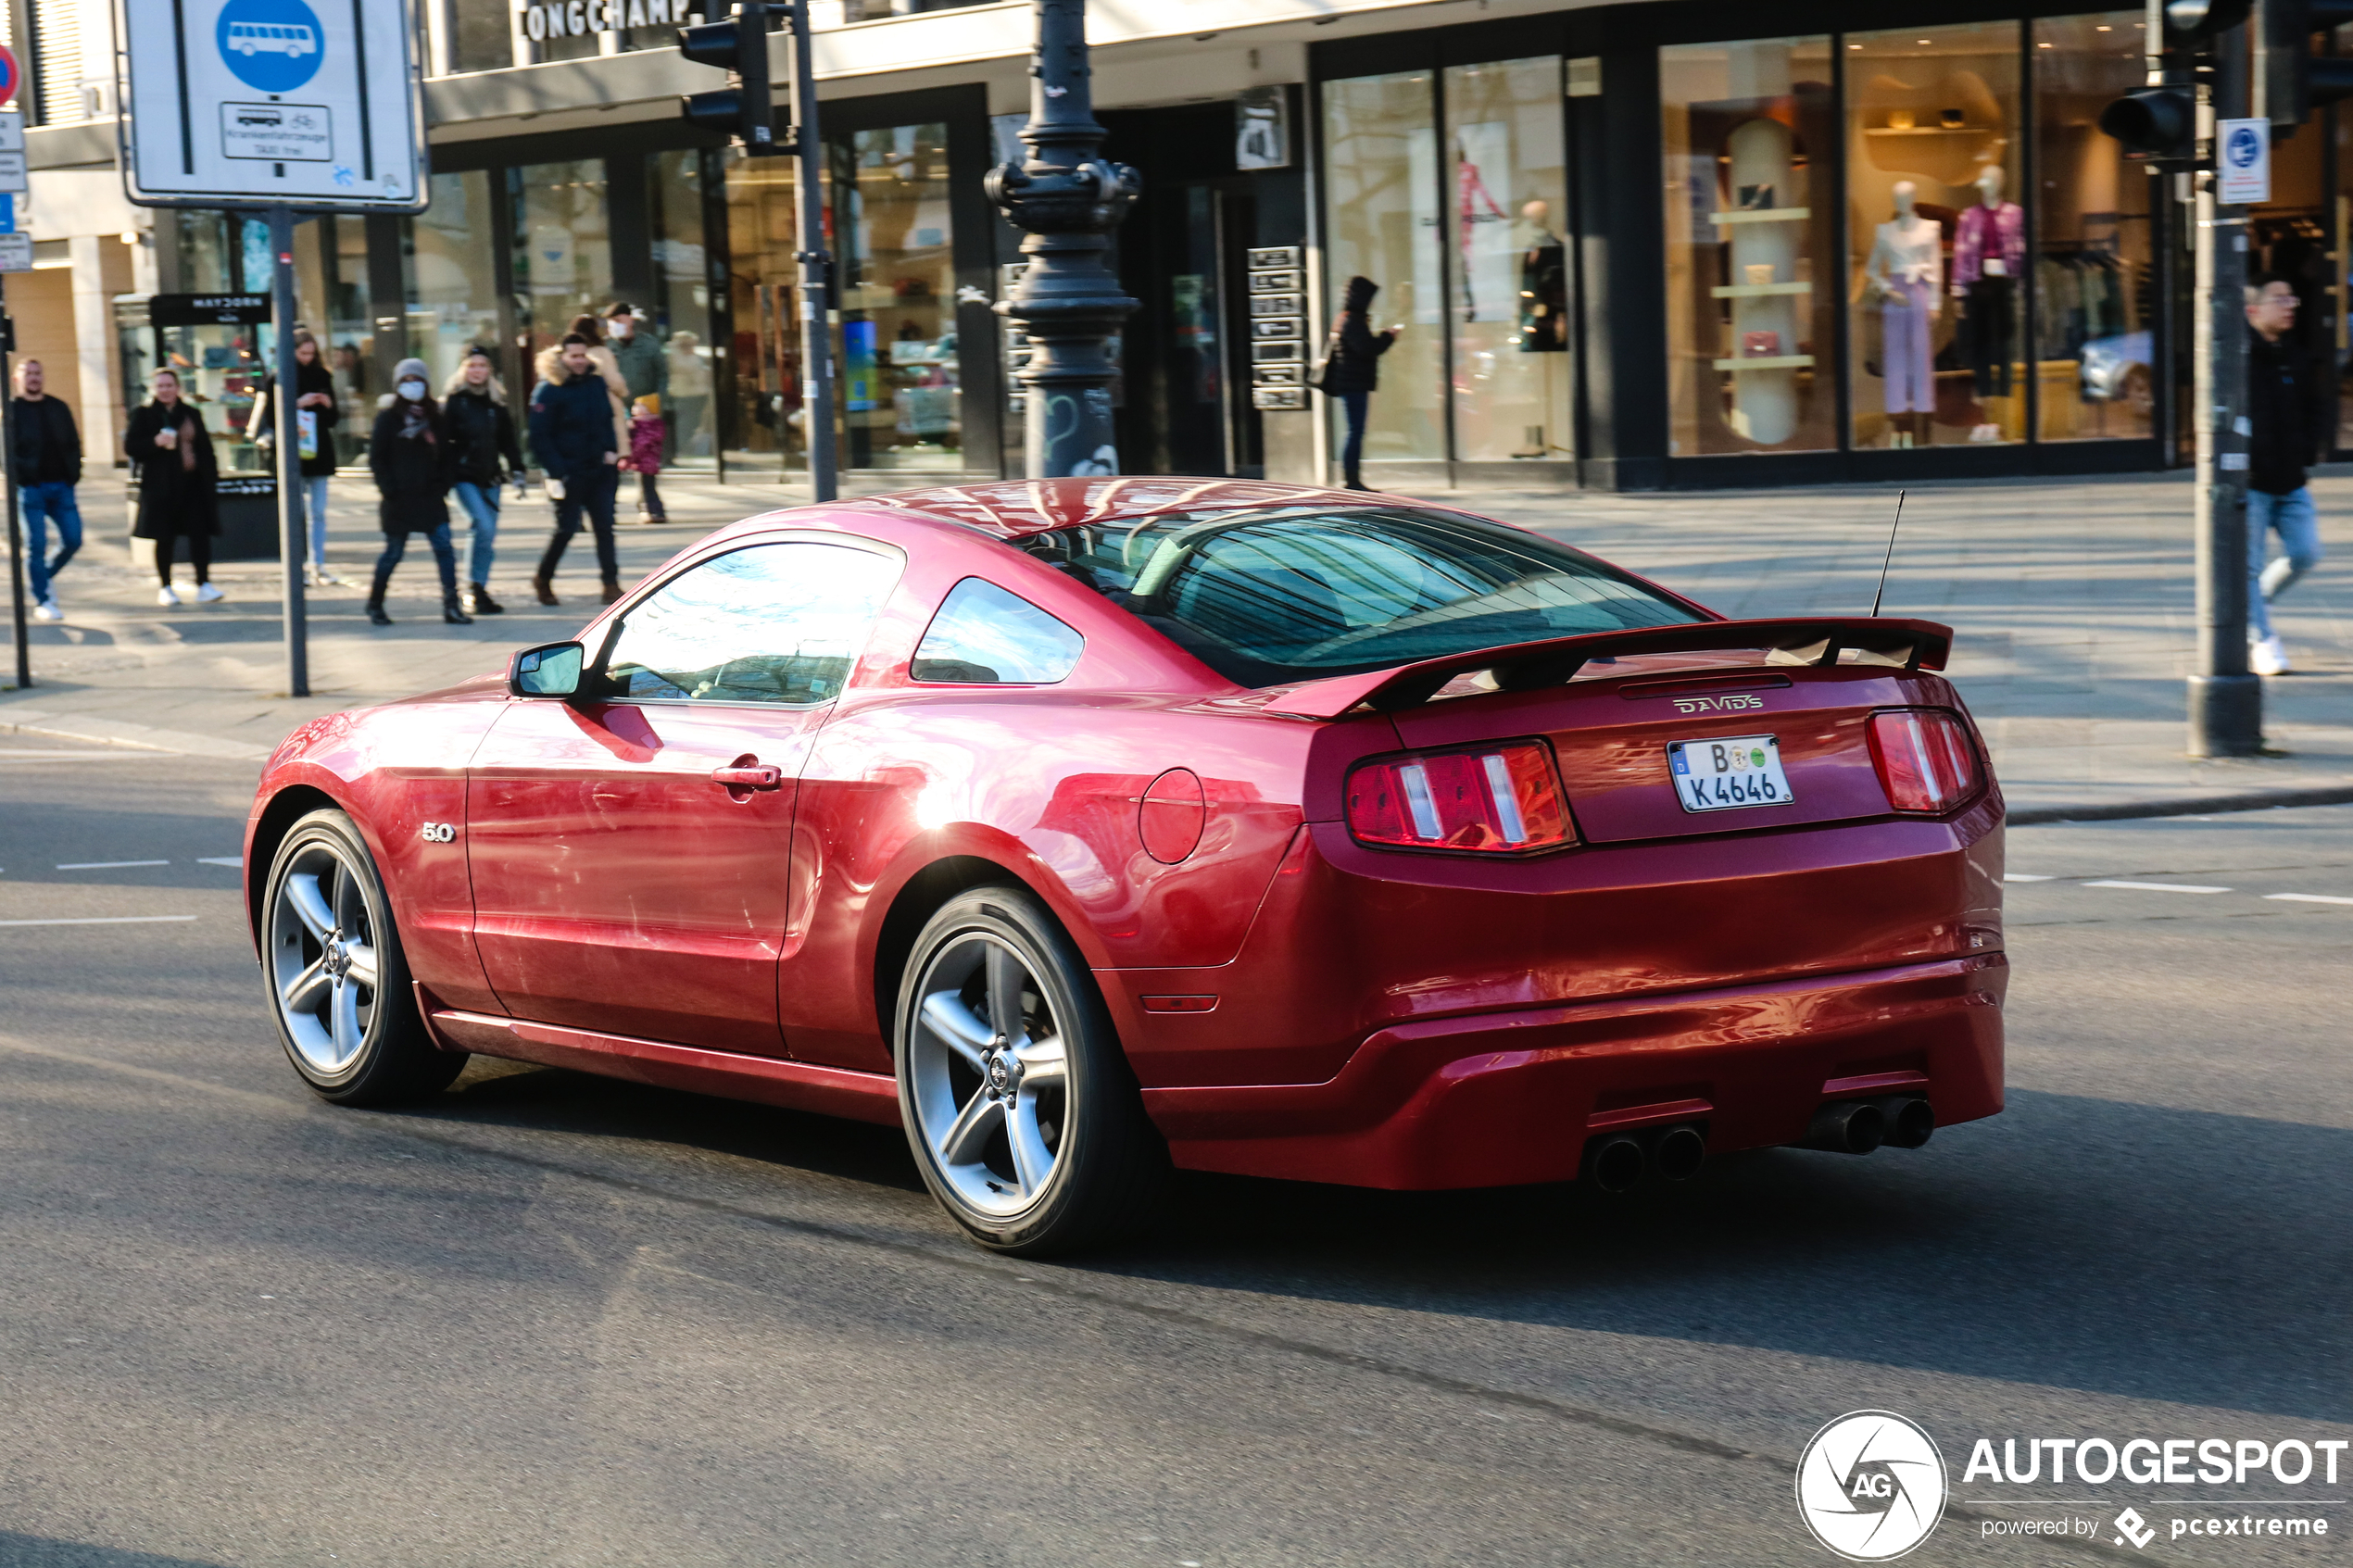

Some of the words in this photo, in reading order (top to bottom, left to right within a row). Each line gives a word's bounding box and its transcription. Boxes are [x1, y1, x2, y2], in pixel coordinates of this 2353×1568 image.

[512, 0, 690, 41] LONGCHAMP
[1677, 762, 1686, 773] D
[1711, 744, 1730, 773] B
[1690, 778, 1713, 807] K
[1716, 773, 1777, 804] 4646
[422, 822, 455, 844] 5.0
